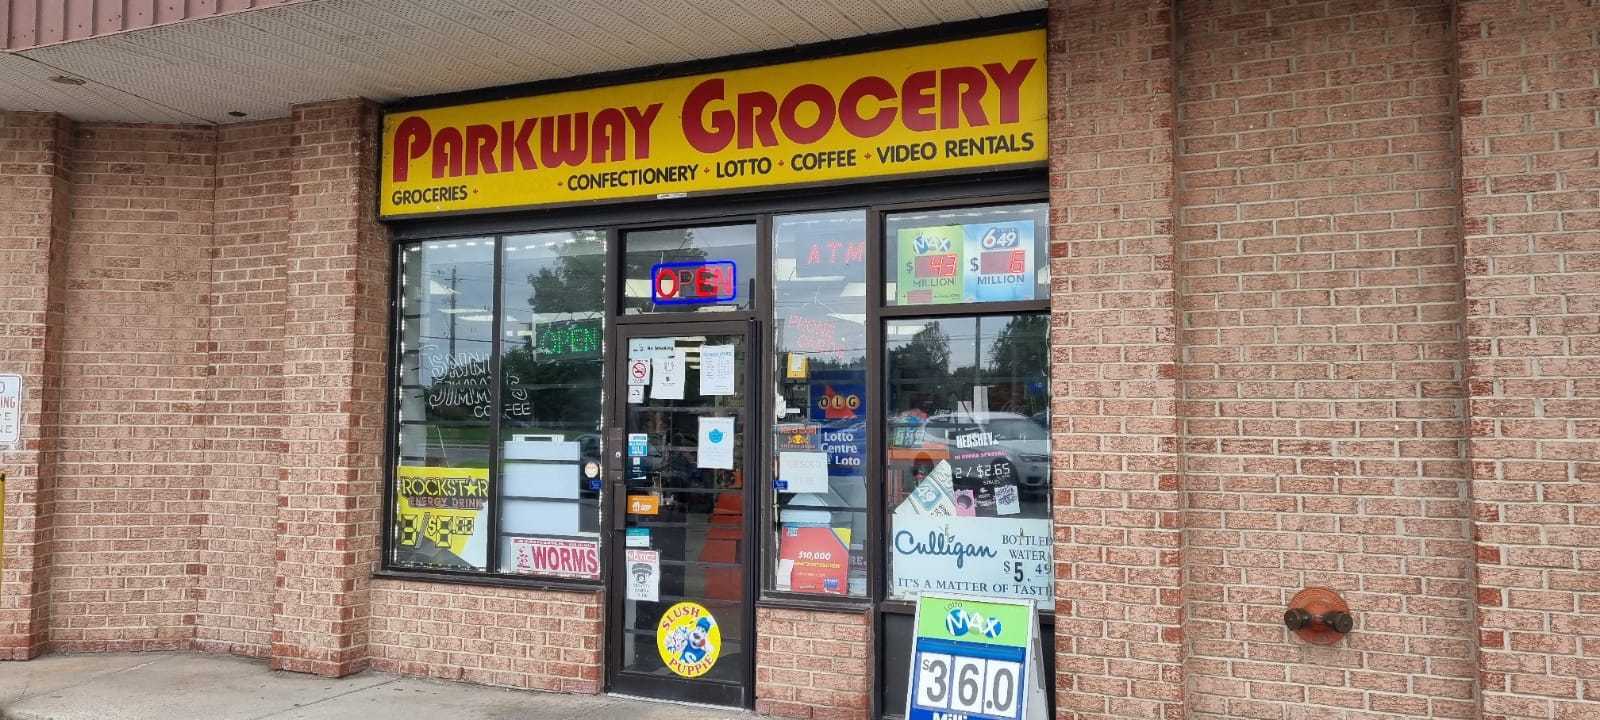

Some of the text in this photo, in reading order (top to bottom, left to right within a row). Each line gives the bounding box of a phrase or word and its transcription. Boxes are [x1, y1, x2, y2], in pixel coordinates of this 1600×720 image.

[393, 58, 1037, 182] PARKWAY GROCERY
[392, 132, 1034, 206] GROCERIES CONFECTIONERY LOTTO COFFEE VIDEO RENTALS
[808, 241, 864, 264] ATM
[929, 254, 958, 276] 43
[655, 267, 732, 299] OPEN
[913, 277, 954, 288] MILLION
[978, 275, 1024, 285] MILLION
[541, 328, 598, 353] OPEN
[474, 402, 532, 419] COFEE
[824, 432, 853, 442] Lotto
[821, 443, 857, 454] Centre
[835, 456, 860, 466] Loto
[955, 467, 962, 479] 2
[977, 463, 1010, 478] $2.65
[409, 496, 481, 509] ENERGY DRINK
[799, 550, 831, 560] $10,000
[895, 530, 997, 568] Culligan
[1009, 549, 1046, 561] WATER
[532, 545, 599, 574] WORMS
[898, 577, 919, 588] IT'S
[924, 579, 932, 589] A
[936, 579, 988, 593] MATTER
[993, 583, 1009, 593] OF
[662, 606, 700, 630] SLUSH
[946, 608, 1001, 639] MAX
[669, 655, 713, 675] PUPPIE
